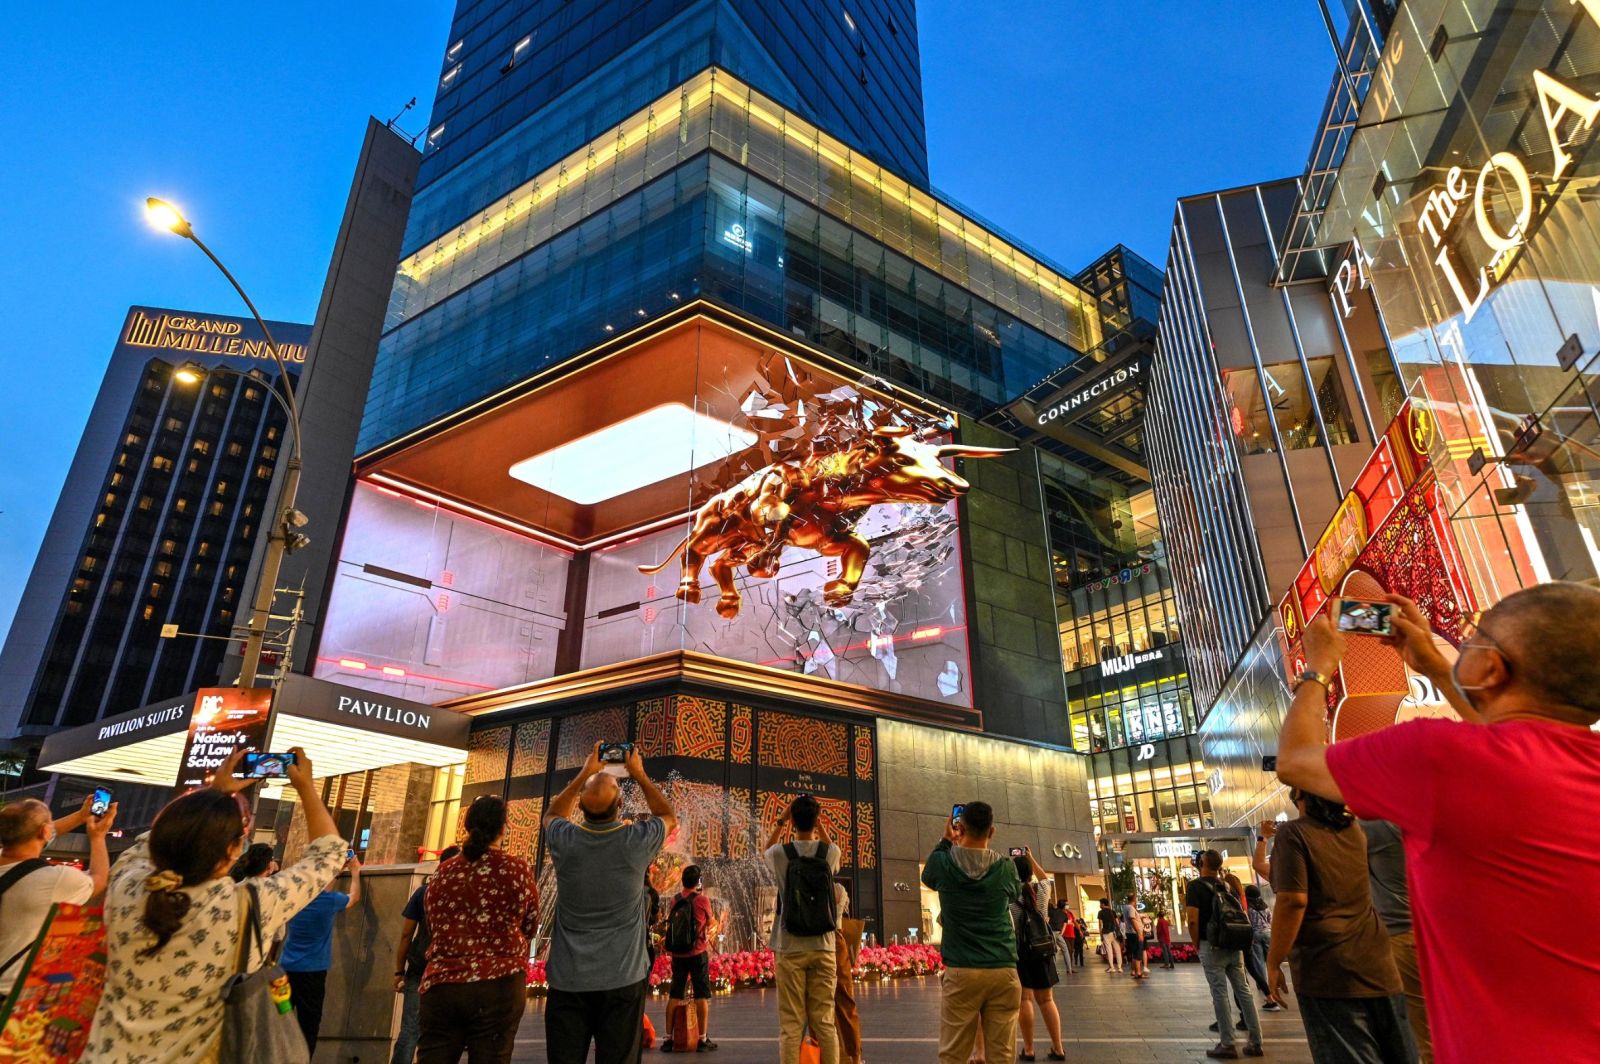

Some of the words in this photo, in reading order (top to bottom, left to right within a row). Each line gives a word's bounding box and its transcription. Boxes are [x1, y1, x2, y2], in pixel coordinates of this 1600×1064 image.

[1435, 0, 1600, 324] LOA
[1418, 166, 1472, 247] The
[168, 316, 241, 335] GRAND
[1038, 362, 1140, 425] CONNECTION
[1101, 654, 1135, 677] MUJI
[98, 716, 145, 740] PAVILION
[145, 705, 184, 726] SUITES
[338, 696, 430, 729] PAVILION
[1130, 710, 1177, 732] KNG
[193, 731, 246, 743] Nation's
[190, 744, 206, 755] #1
[208, 744, 233, 755] Law
[1137, 743, 1155, 761] JD
[784, 779, 826, 792] COACH
[1053, 843, 1082, 859] COS
